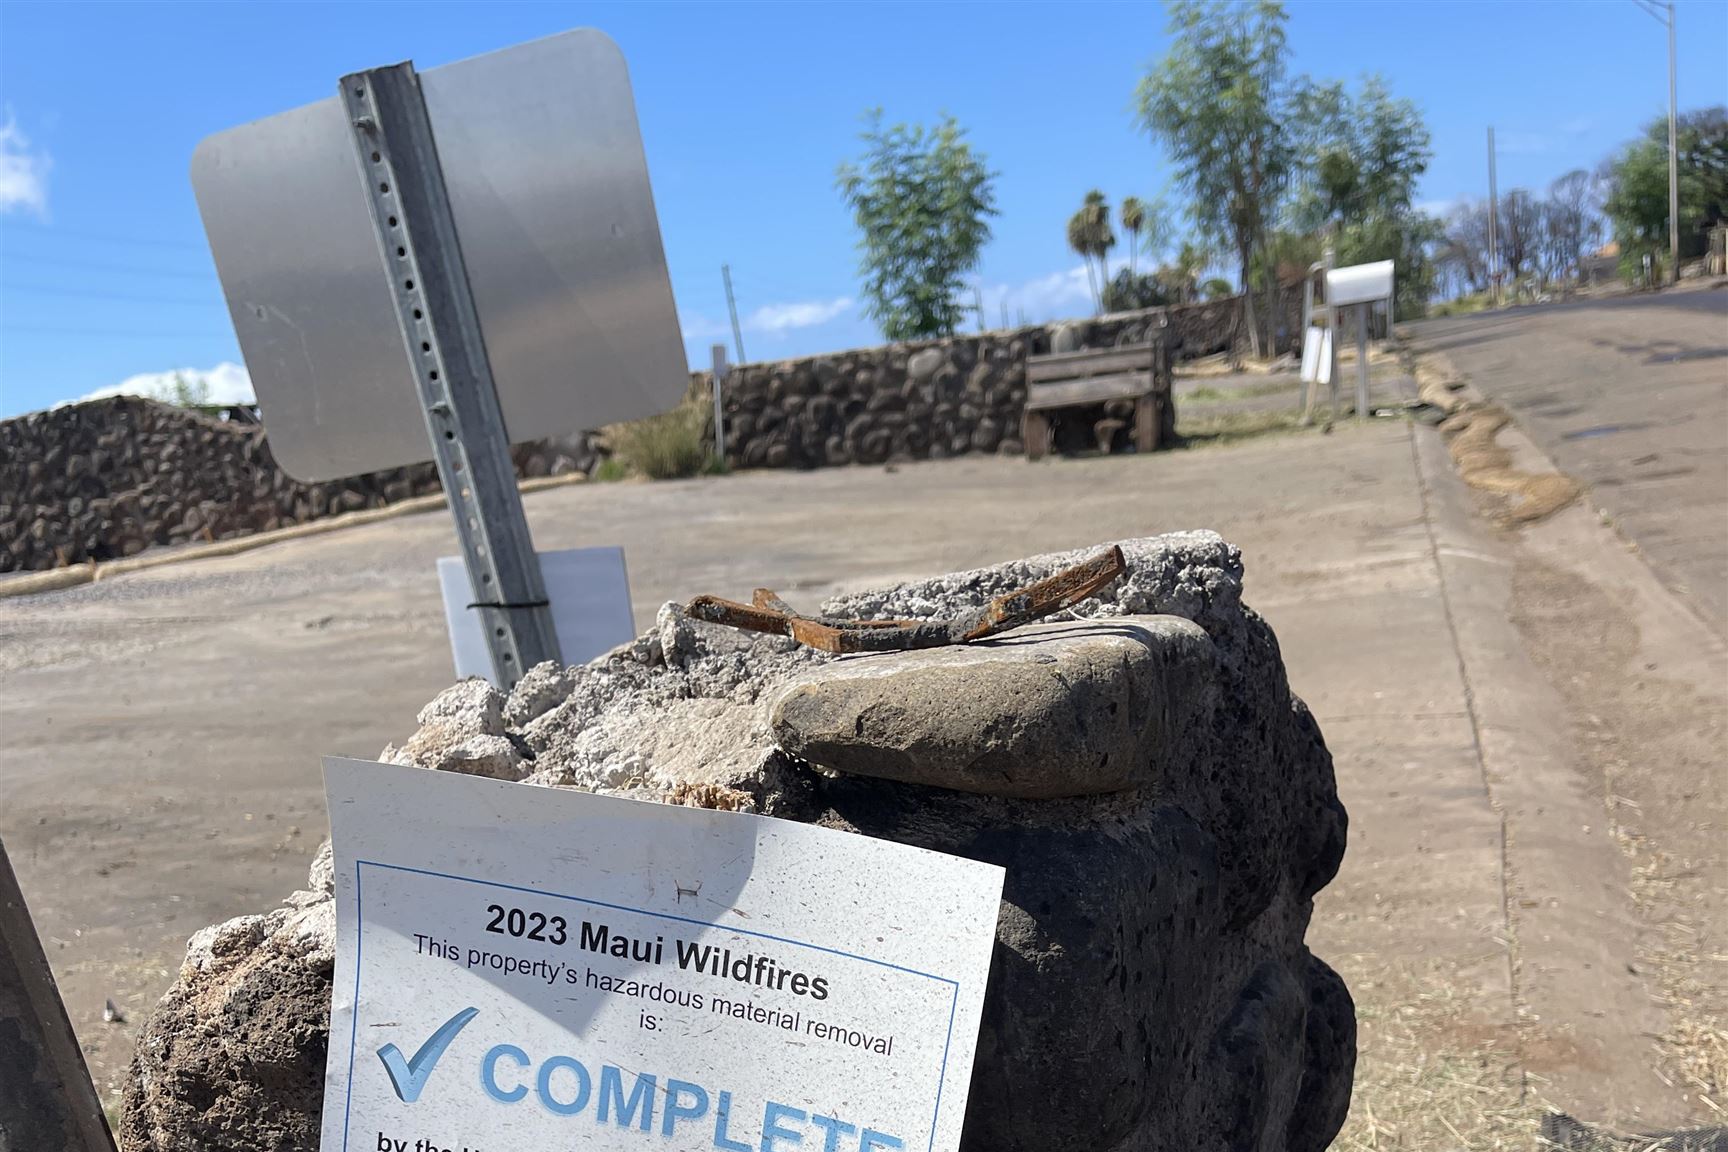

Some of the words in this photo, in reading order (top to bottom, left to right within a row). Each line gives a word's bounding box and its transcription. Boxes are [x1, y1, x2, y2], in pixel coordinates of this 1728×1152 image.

[413, 934, 459, 961] This
[586, 968, 703, 1010] hazardous
[711, 997, 800, 1032] material
[806, 1019, 893, 1056] removal
[485, 904, 567, 946] 2023
[580, 921, 664, 965] Maui
[676, 939, 829, 1000] Wildfires
[639, 1009, 664, 1032] is:
